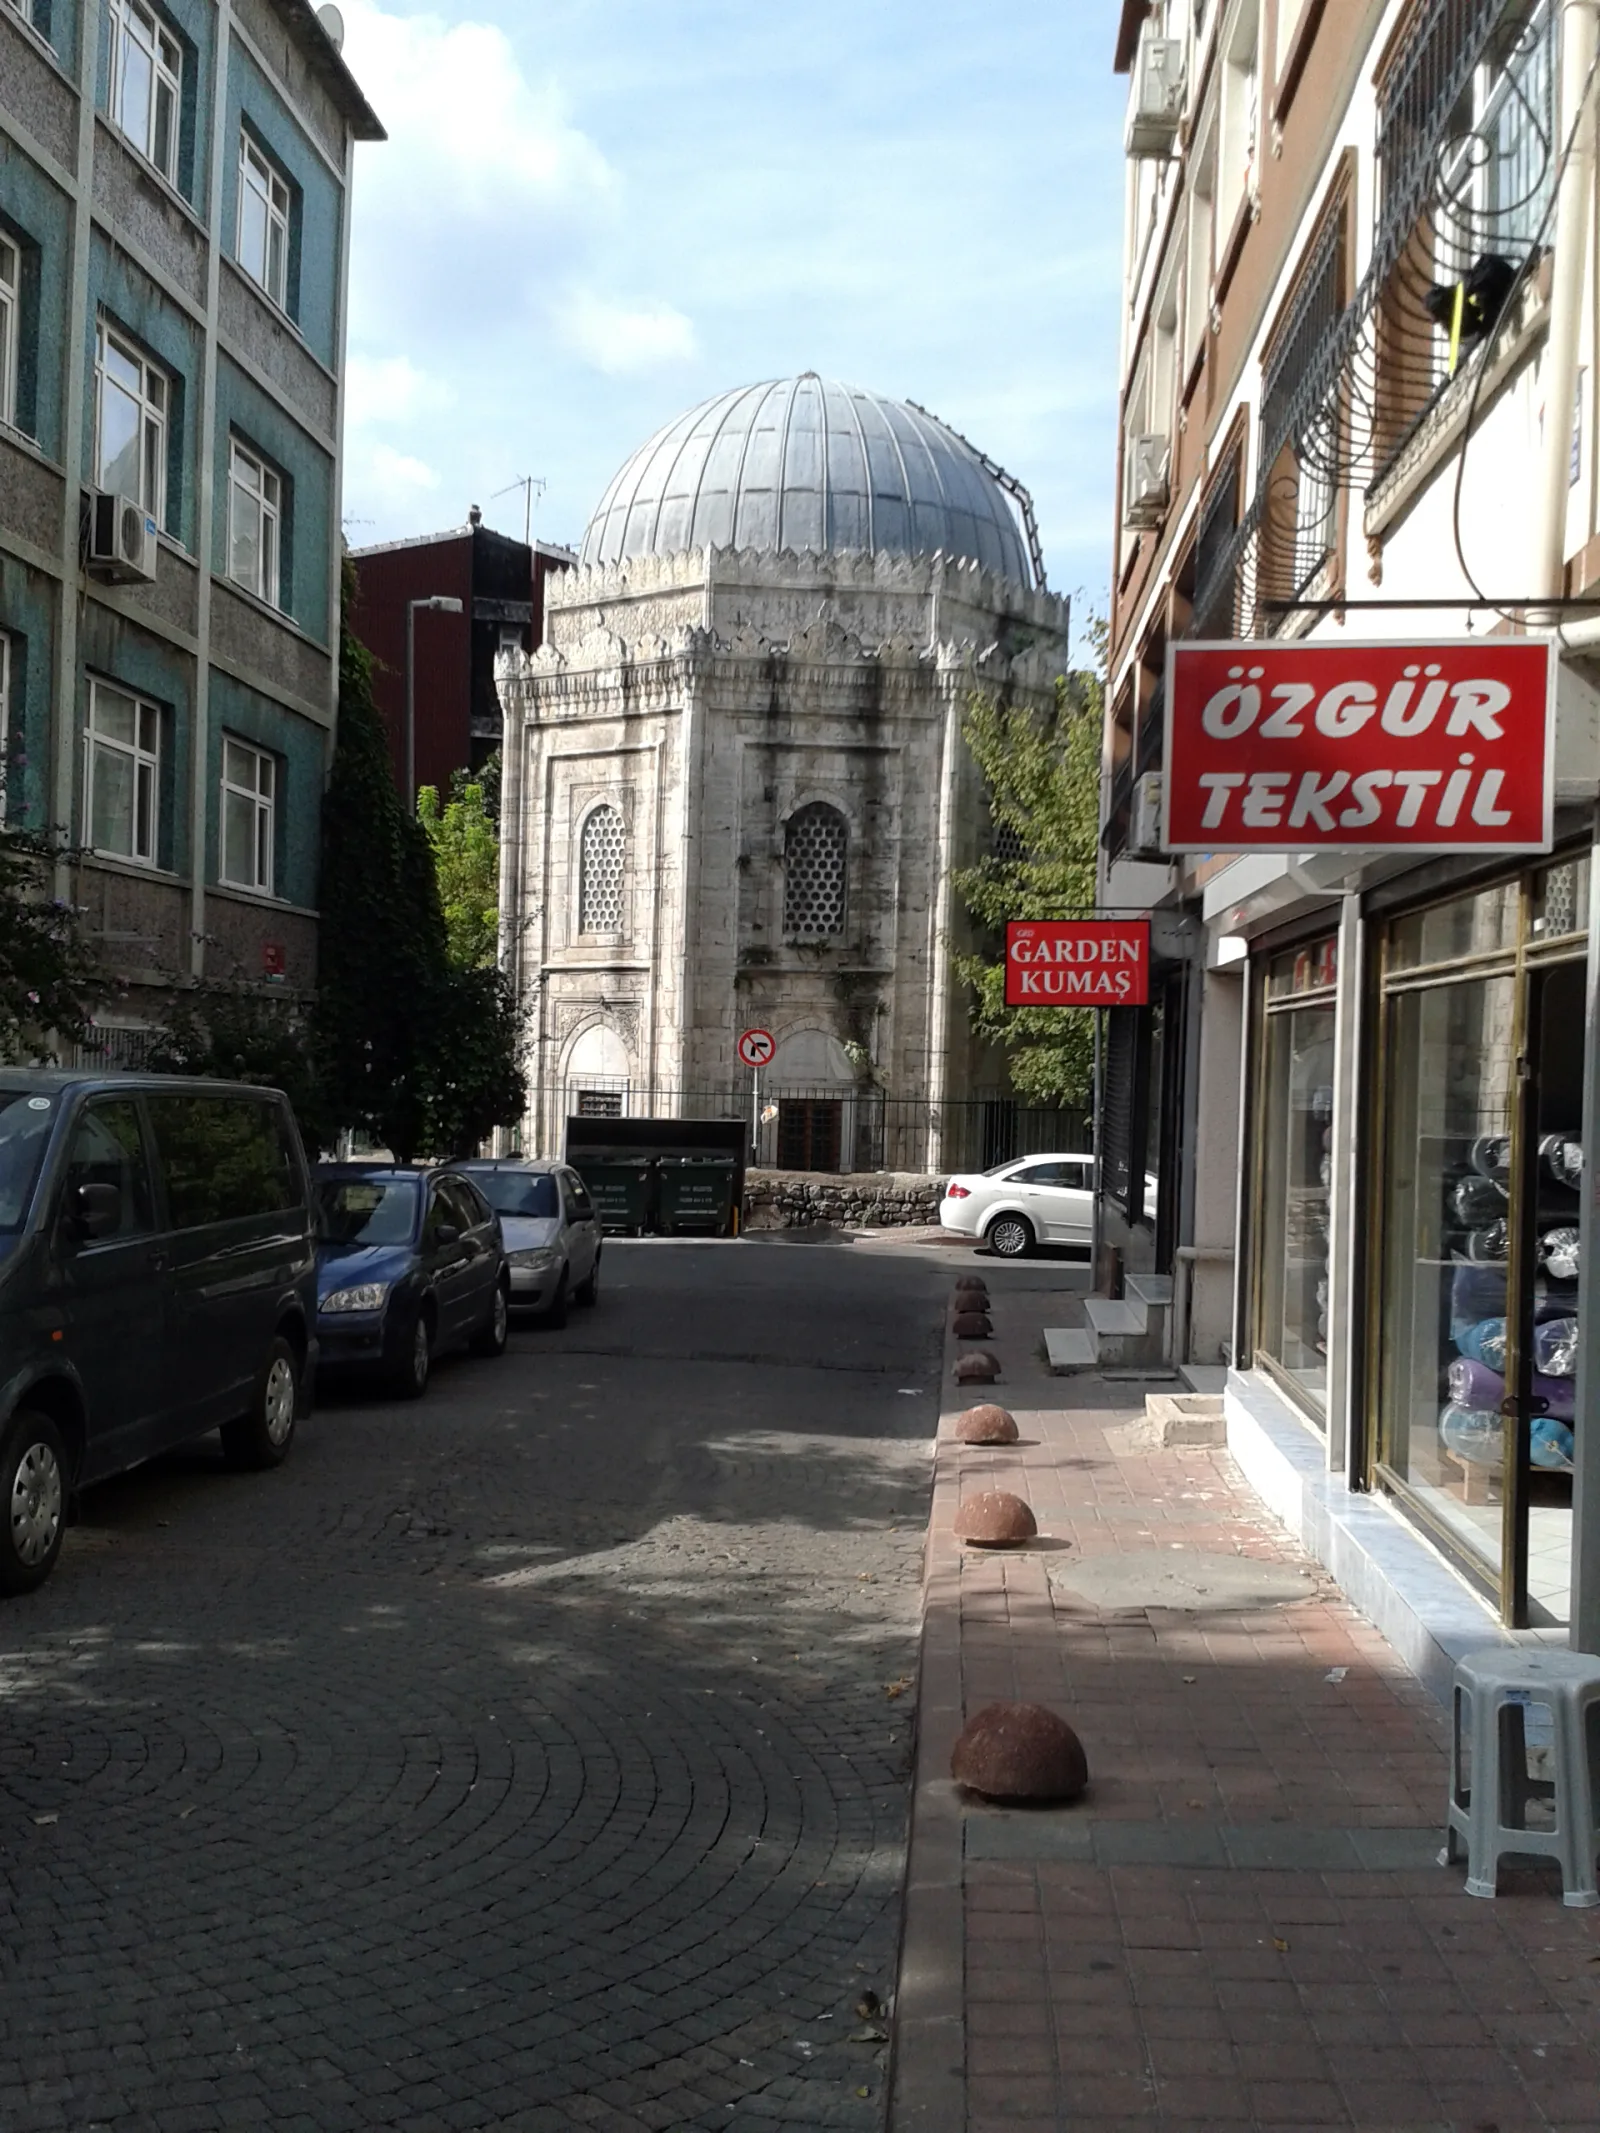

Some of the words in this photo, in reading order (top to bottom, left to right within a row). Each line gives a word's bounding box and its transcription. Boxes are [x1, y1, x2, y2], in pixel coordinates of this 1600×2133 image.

[1202, 663, 1512, 740] ÖZGÜR
[1198, 752, 1512, 832] TEKSTİL
[1010, 939, 1140, 963] GARDEN
[1020, 970, 1131, 1000] KUMAŞ
